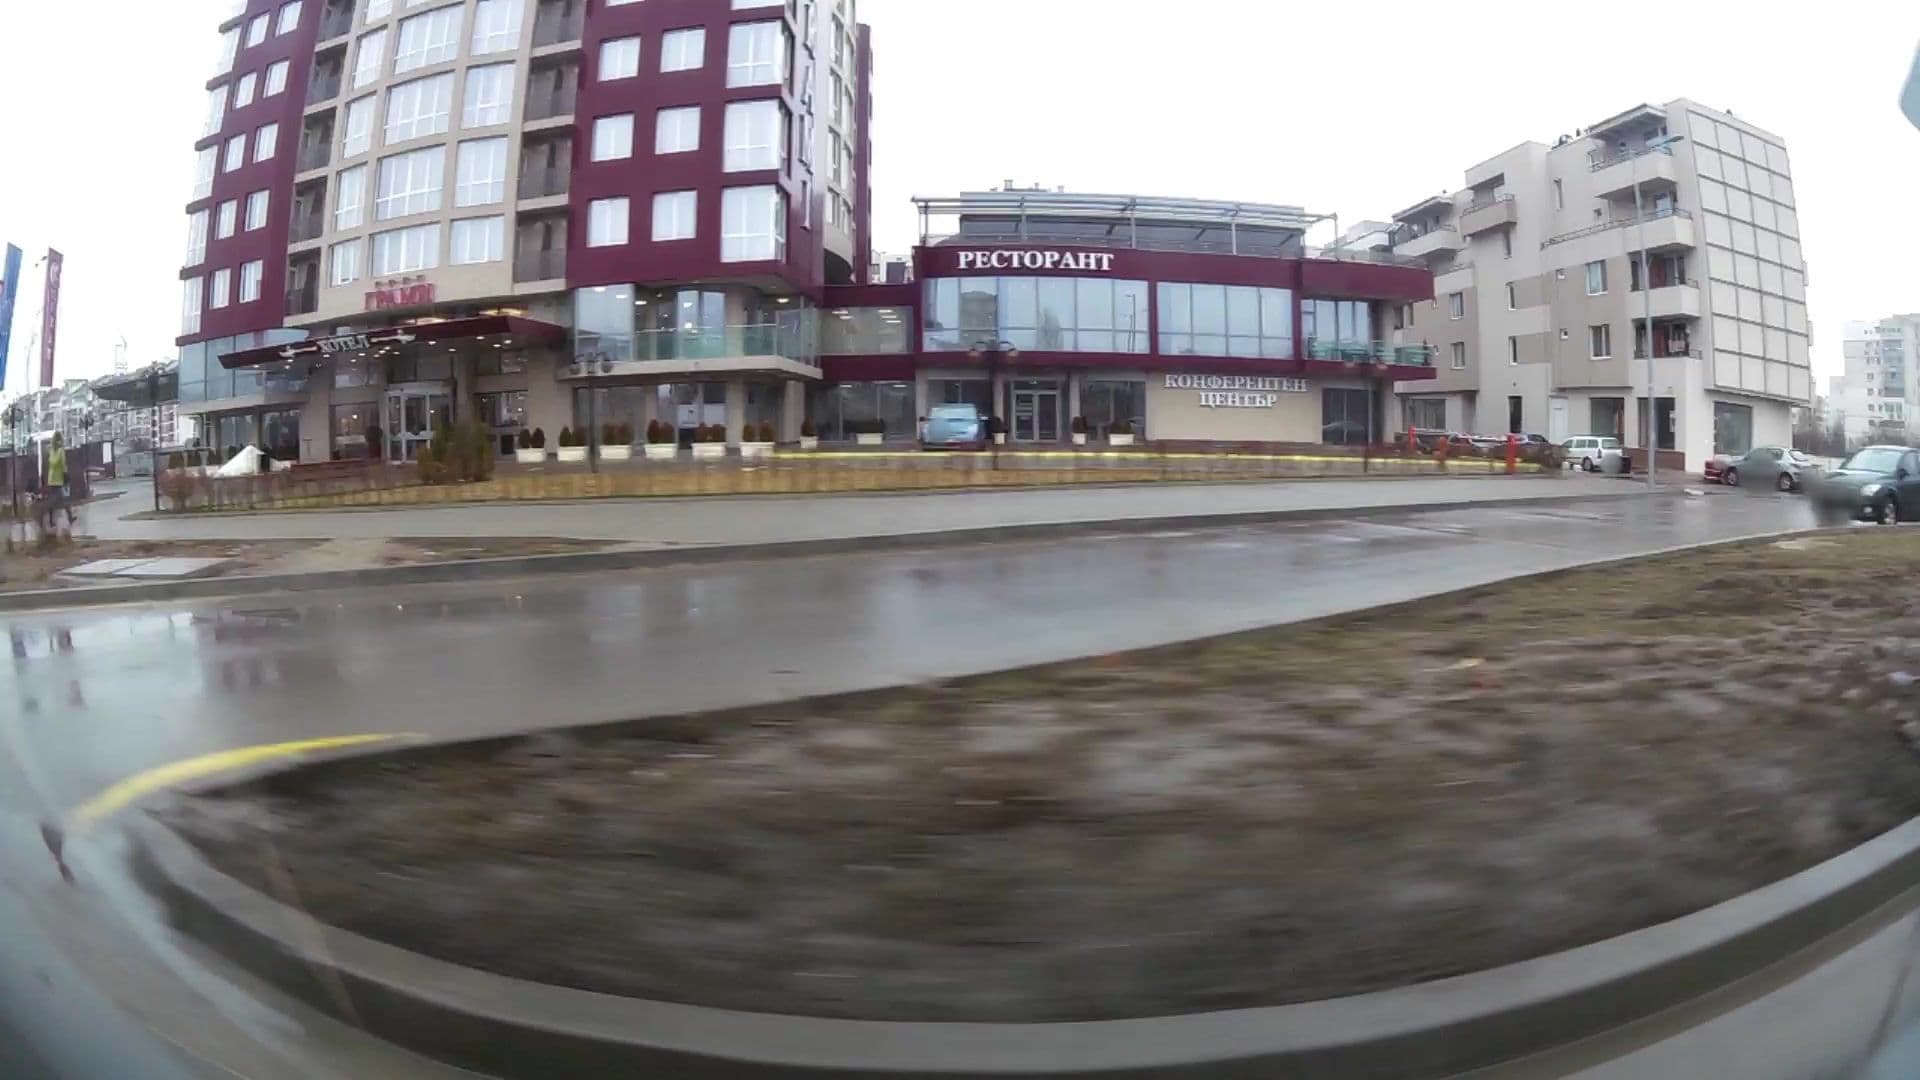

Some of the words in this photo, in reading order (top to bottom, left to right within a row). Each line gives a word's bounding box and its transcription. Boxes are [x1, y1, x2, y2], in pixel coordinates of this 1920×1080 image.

[957, 250, 1115, 271] РЕСТОРАНТ
[316, 334, 371, 353] ХОТЕЛ
[1200, 392, 1278, 408] ЦЕНТЪР
